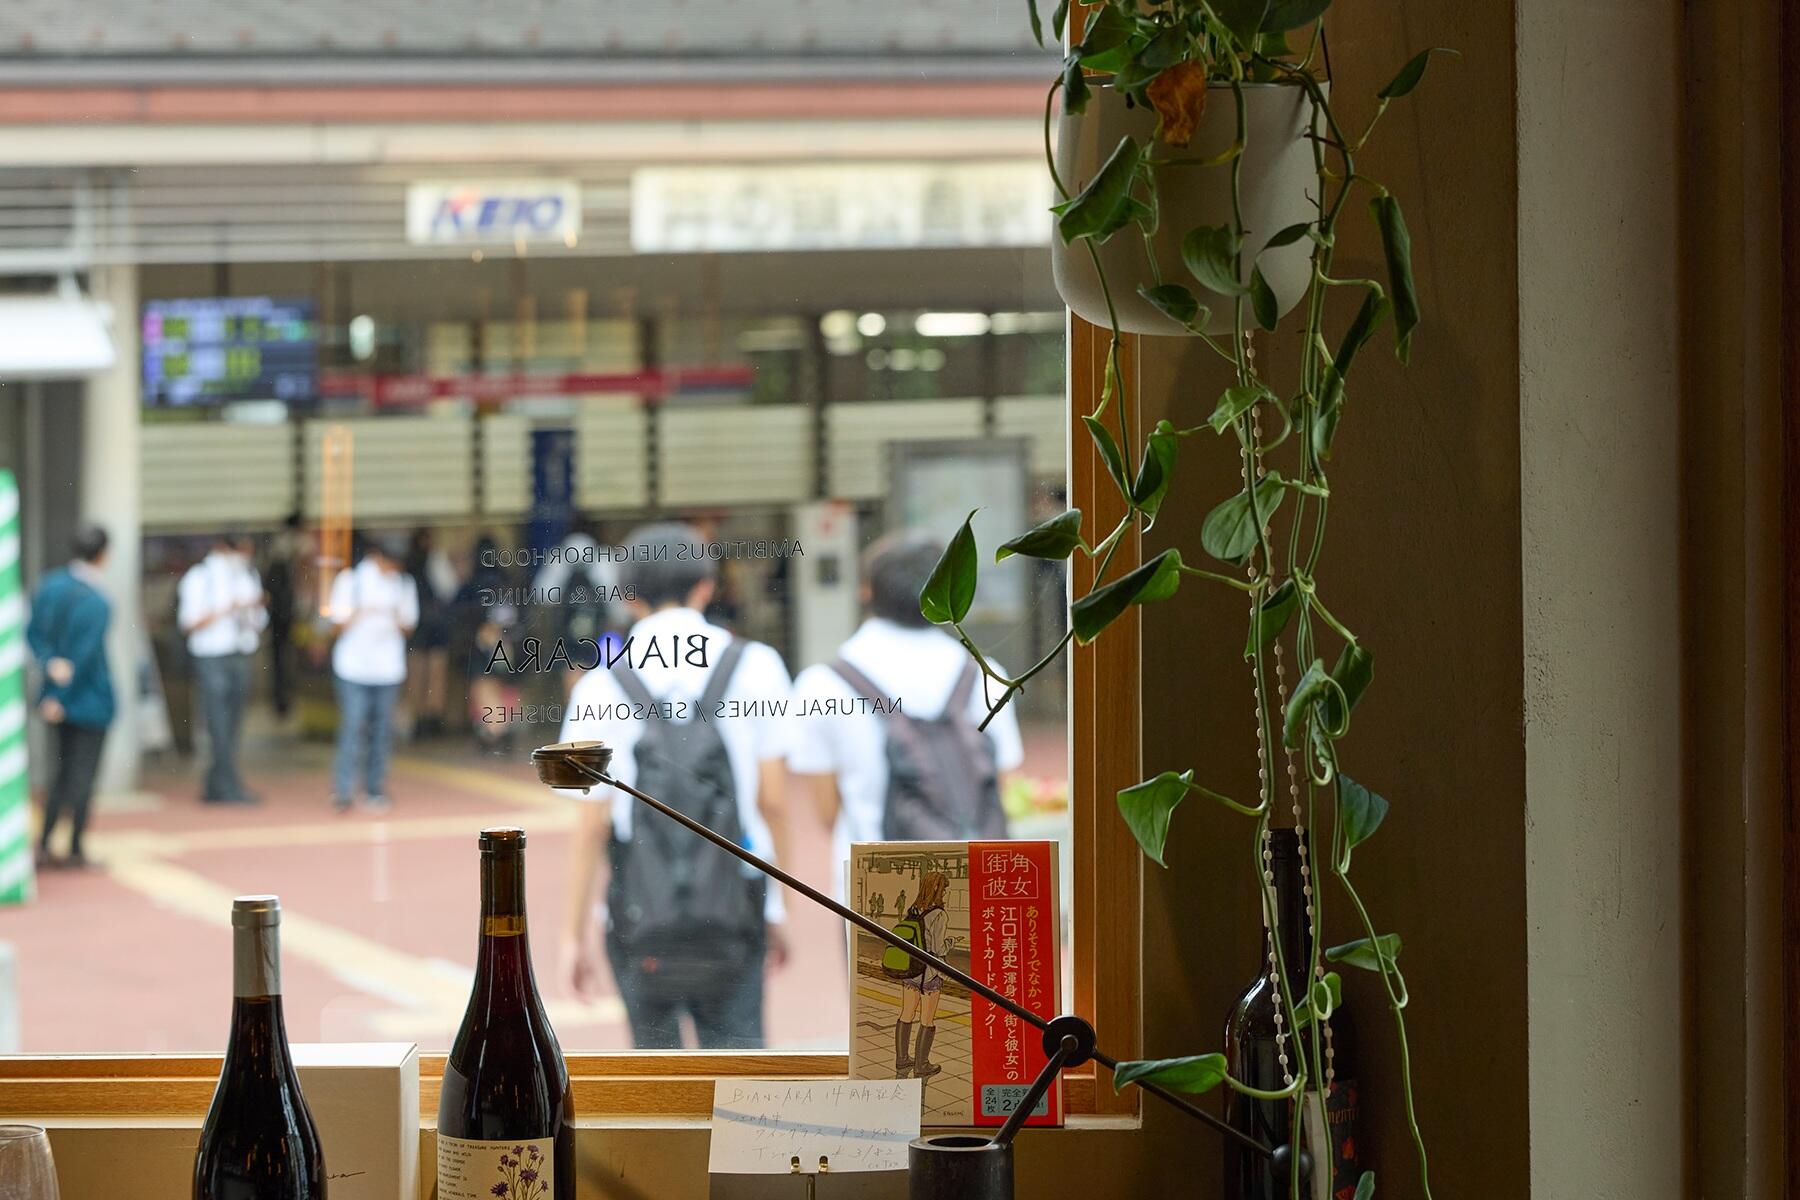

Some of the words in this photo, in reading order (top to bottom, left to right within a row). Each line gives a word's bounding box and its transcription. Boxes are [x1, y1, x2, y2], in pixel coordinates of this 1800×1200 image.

[987, 853, 1030, 873] 街角
[987, 876, 1032, 896] 彼女
[1025, 905, 1042, 1009] ありそうでなかっ
[985, 1096, 997, 1105] 24
